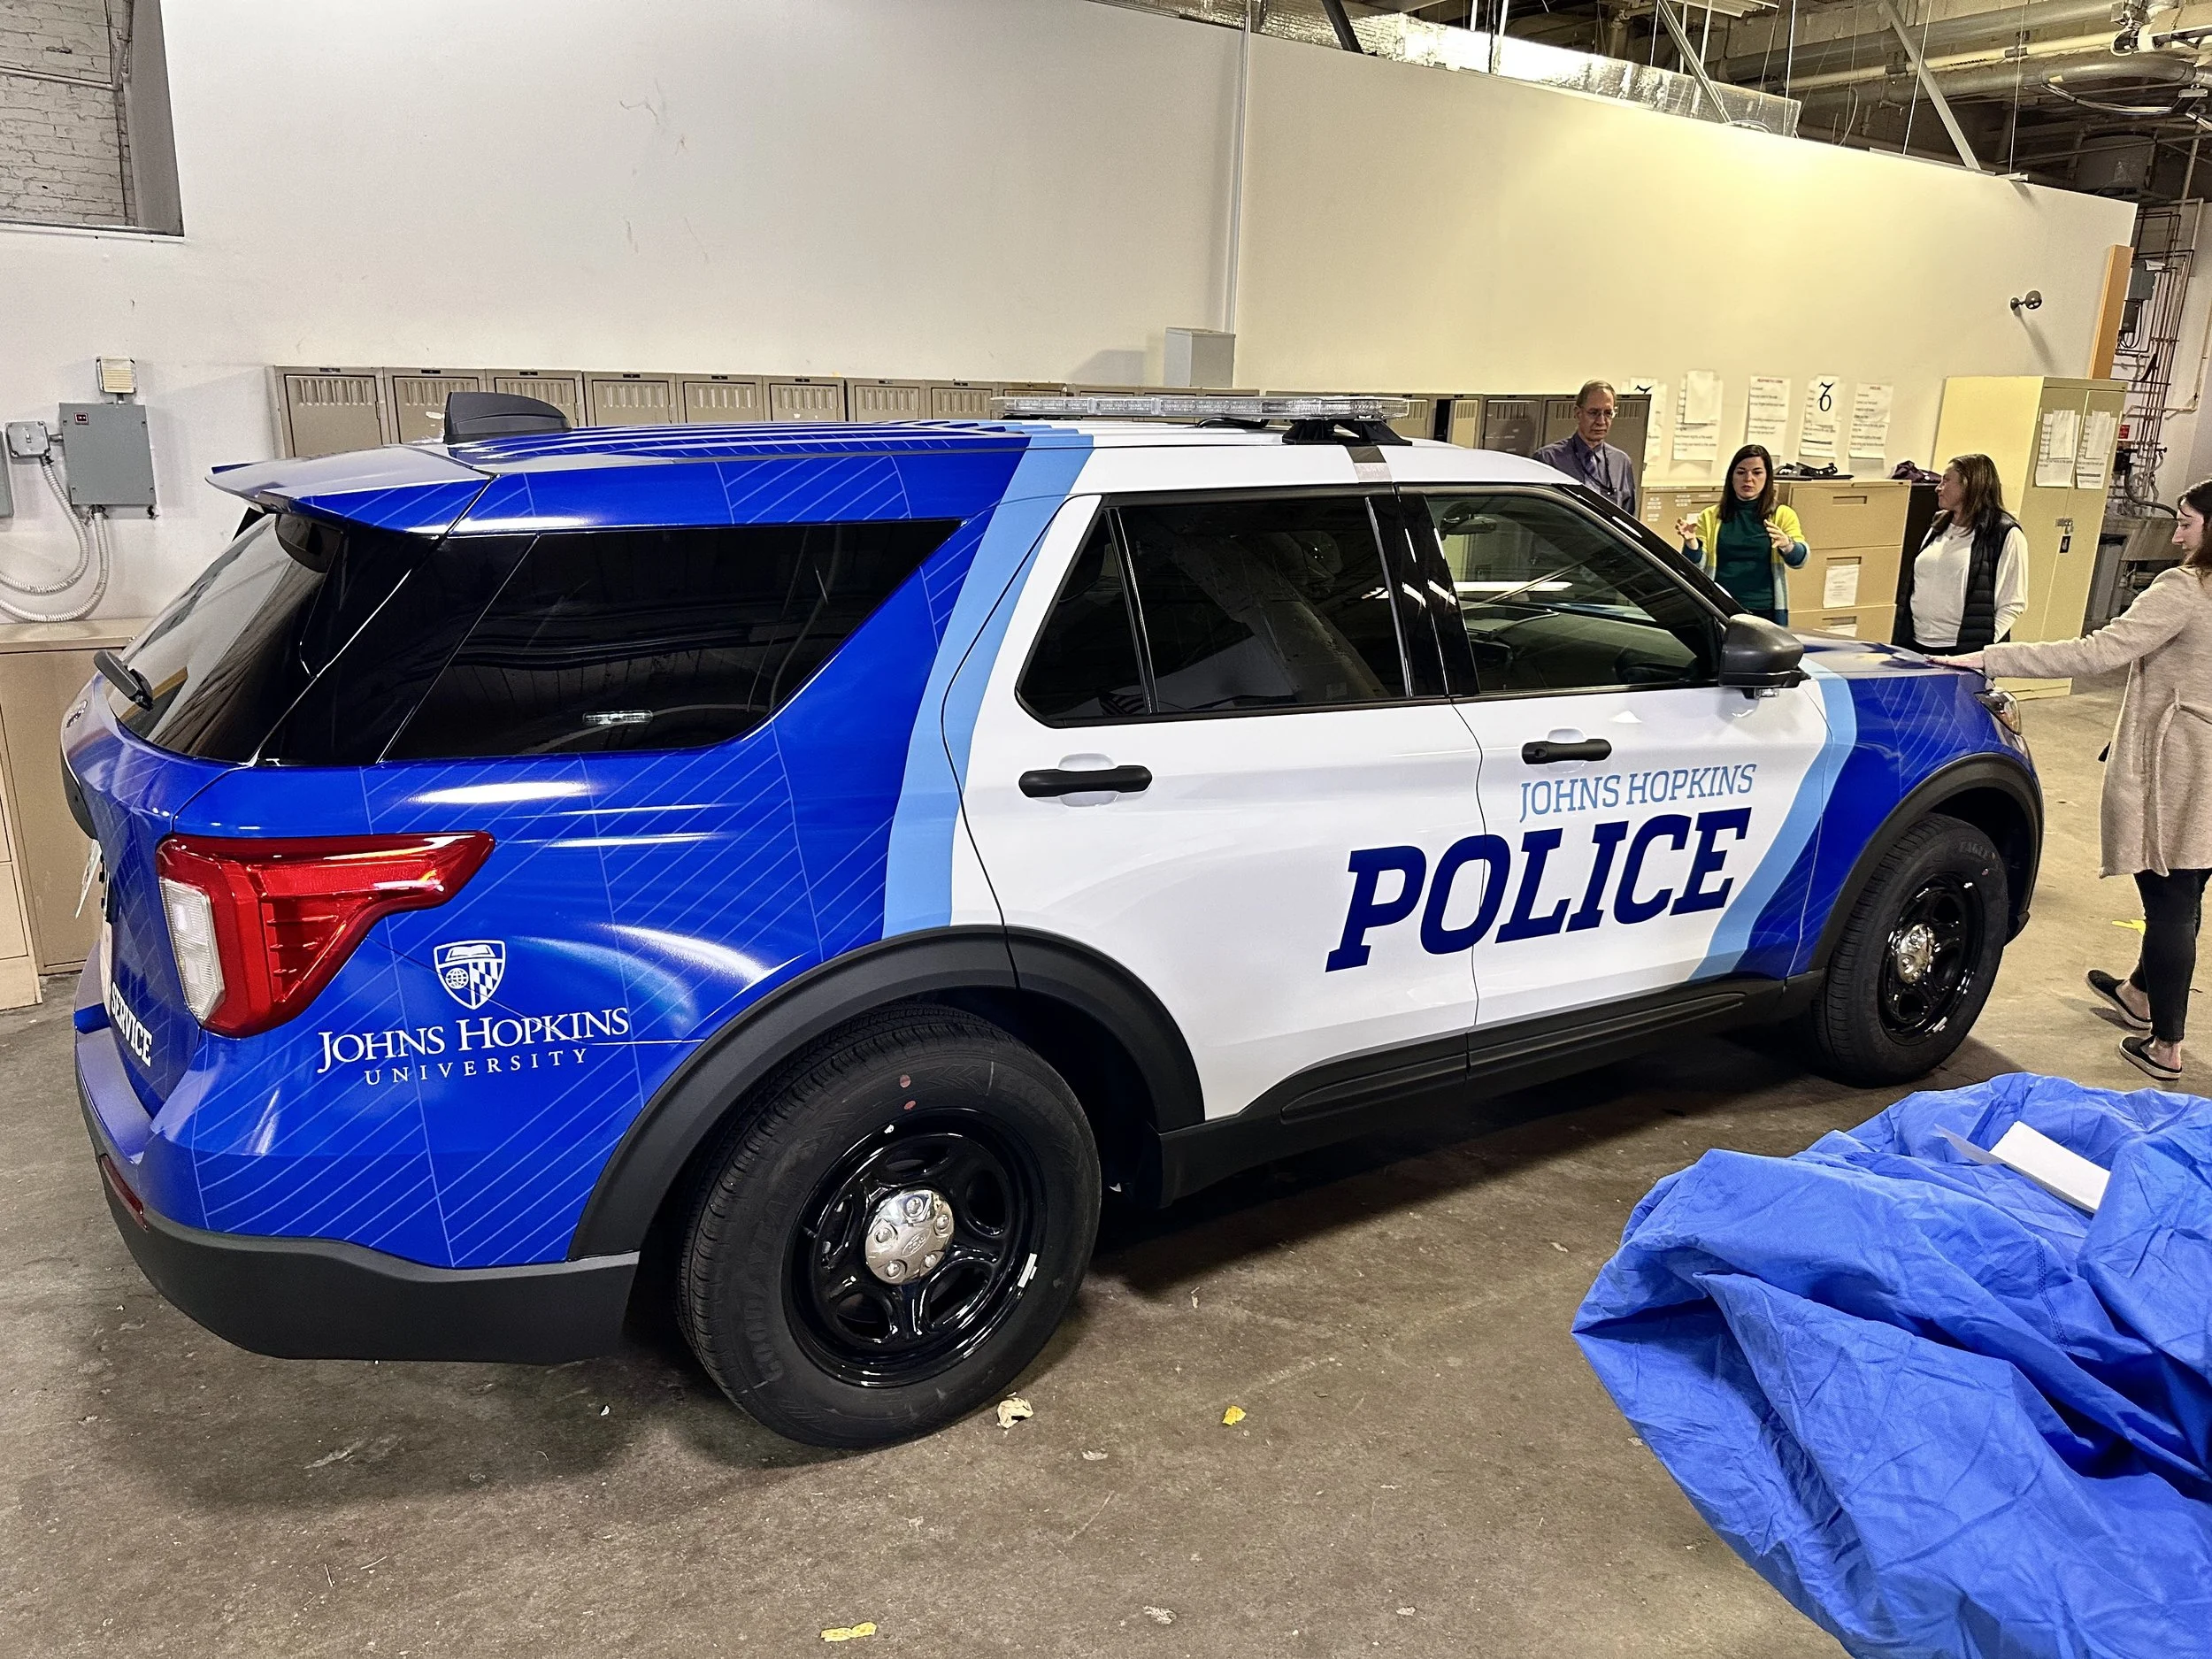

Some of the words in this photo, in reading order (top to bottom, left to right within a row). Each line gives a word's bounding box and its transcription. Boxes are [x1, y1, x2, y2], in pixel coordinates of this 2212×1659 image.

[1519, 774, 1621, 823] JOHNS
[1625, 764, 1757, 805] HOPKINS
[1325, 807, 1753, 973] POLICE
[111, 981, 153, 1068] SERVICE
[317, 1025, 445, 1074] JOHNS
[455, 1007, 631, 1052] HOPKINS
[364, 1048, 588, 1087] UNIVERSITY
